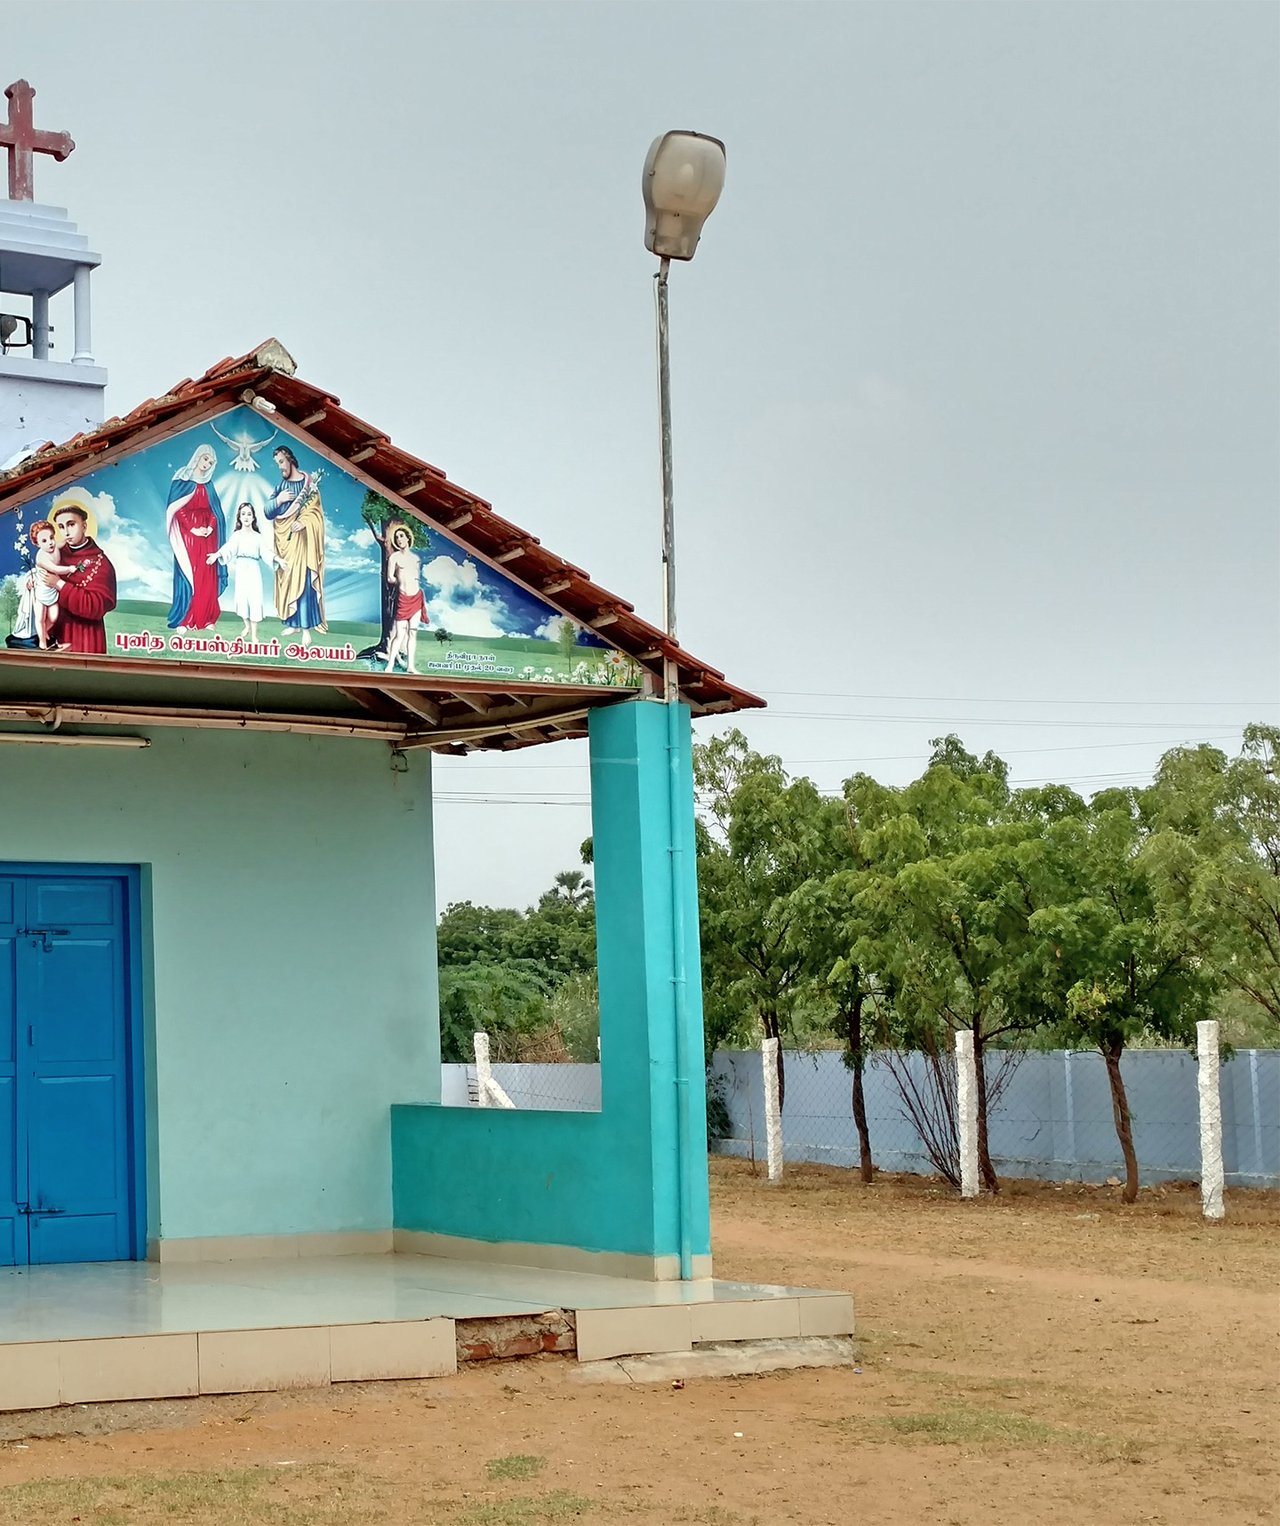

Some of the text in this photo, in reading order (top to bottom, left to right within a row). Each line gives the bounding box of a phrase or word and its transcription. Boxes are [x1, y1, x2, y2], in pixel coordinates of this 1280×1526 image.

[116, 631, 356, 660] புனித செபஸ்தியார் ஆலயம்
